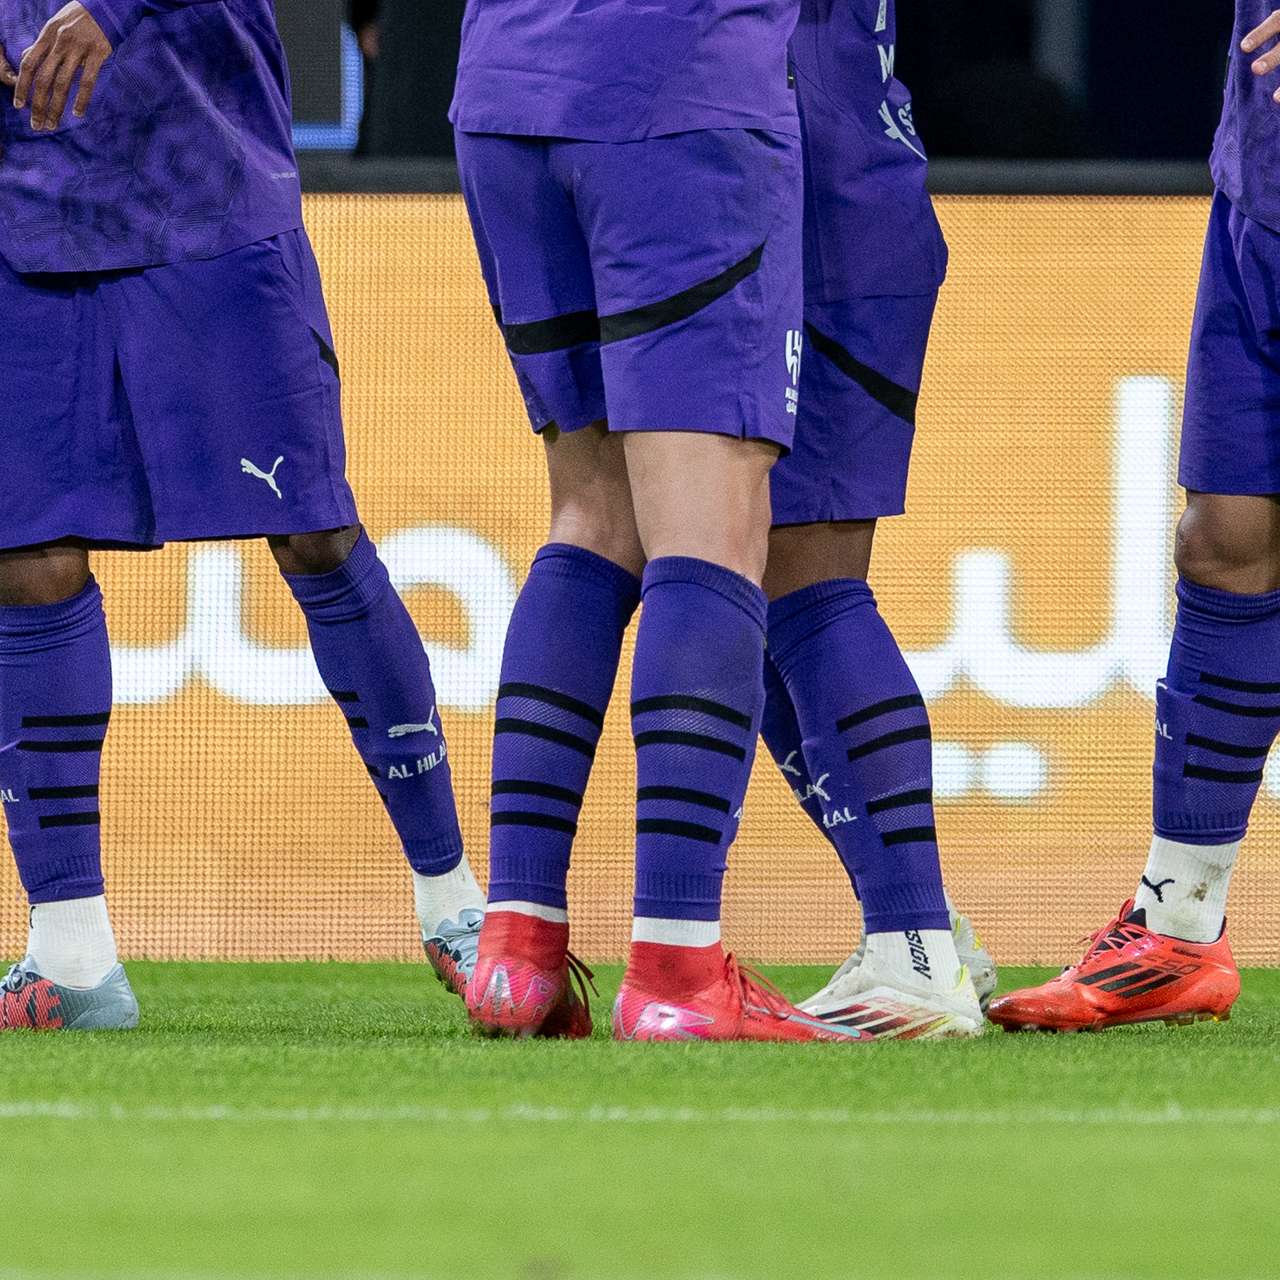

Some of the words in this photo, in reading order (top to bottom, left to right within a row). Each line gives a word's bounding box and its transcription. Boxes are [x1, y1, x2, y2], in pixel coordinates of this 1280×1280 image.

[388, 763, 414, 779] AL
[416, 740, 446, 775] HILA
[822, 806, 858, 829] LAL
[904, 928, 932, 981] SIGN
